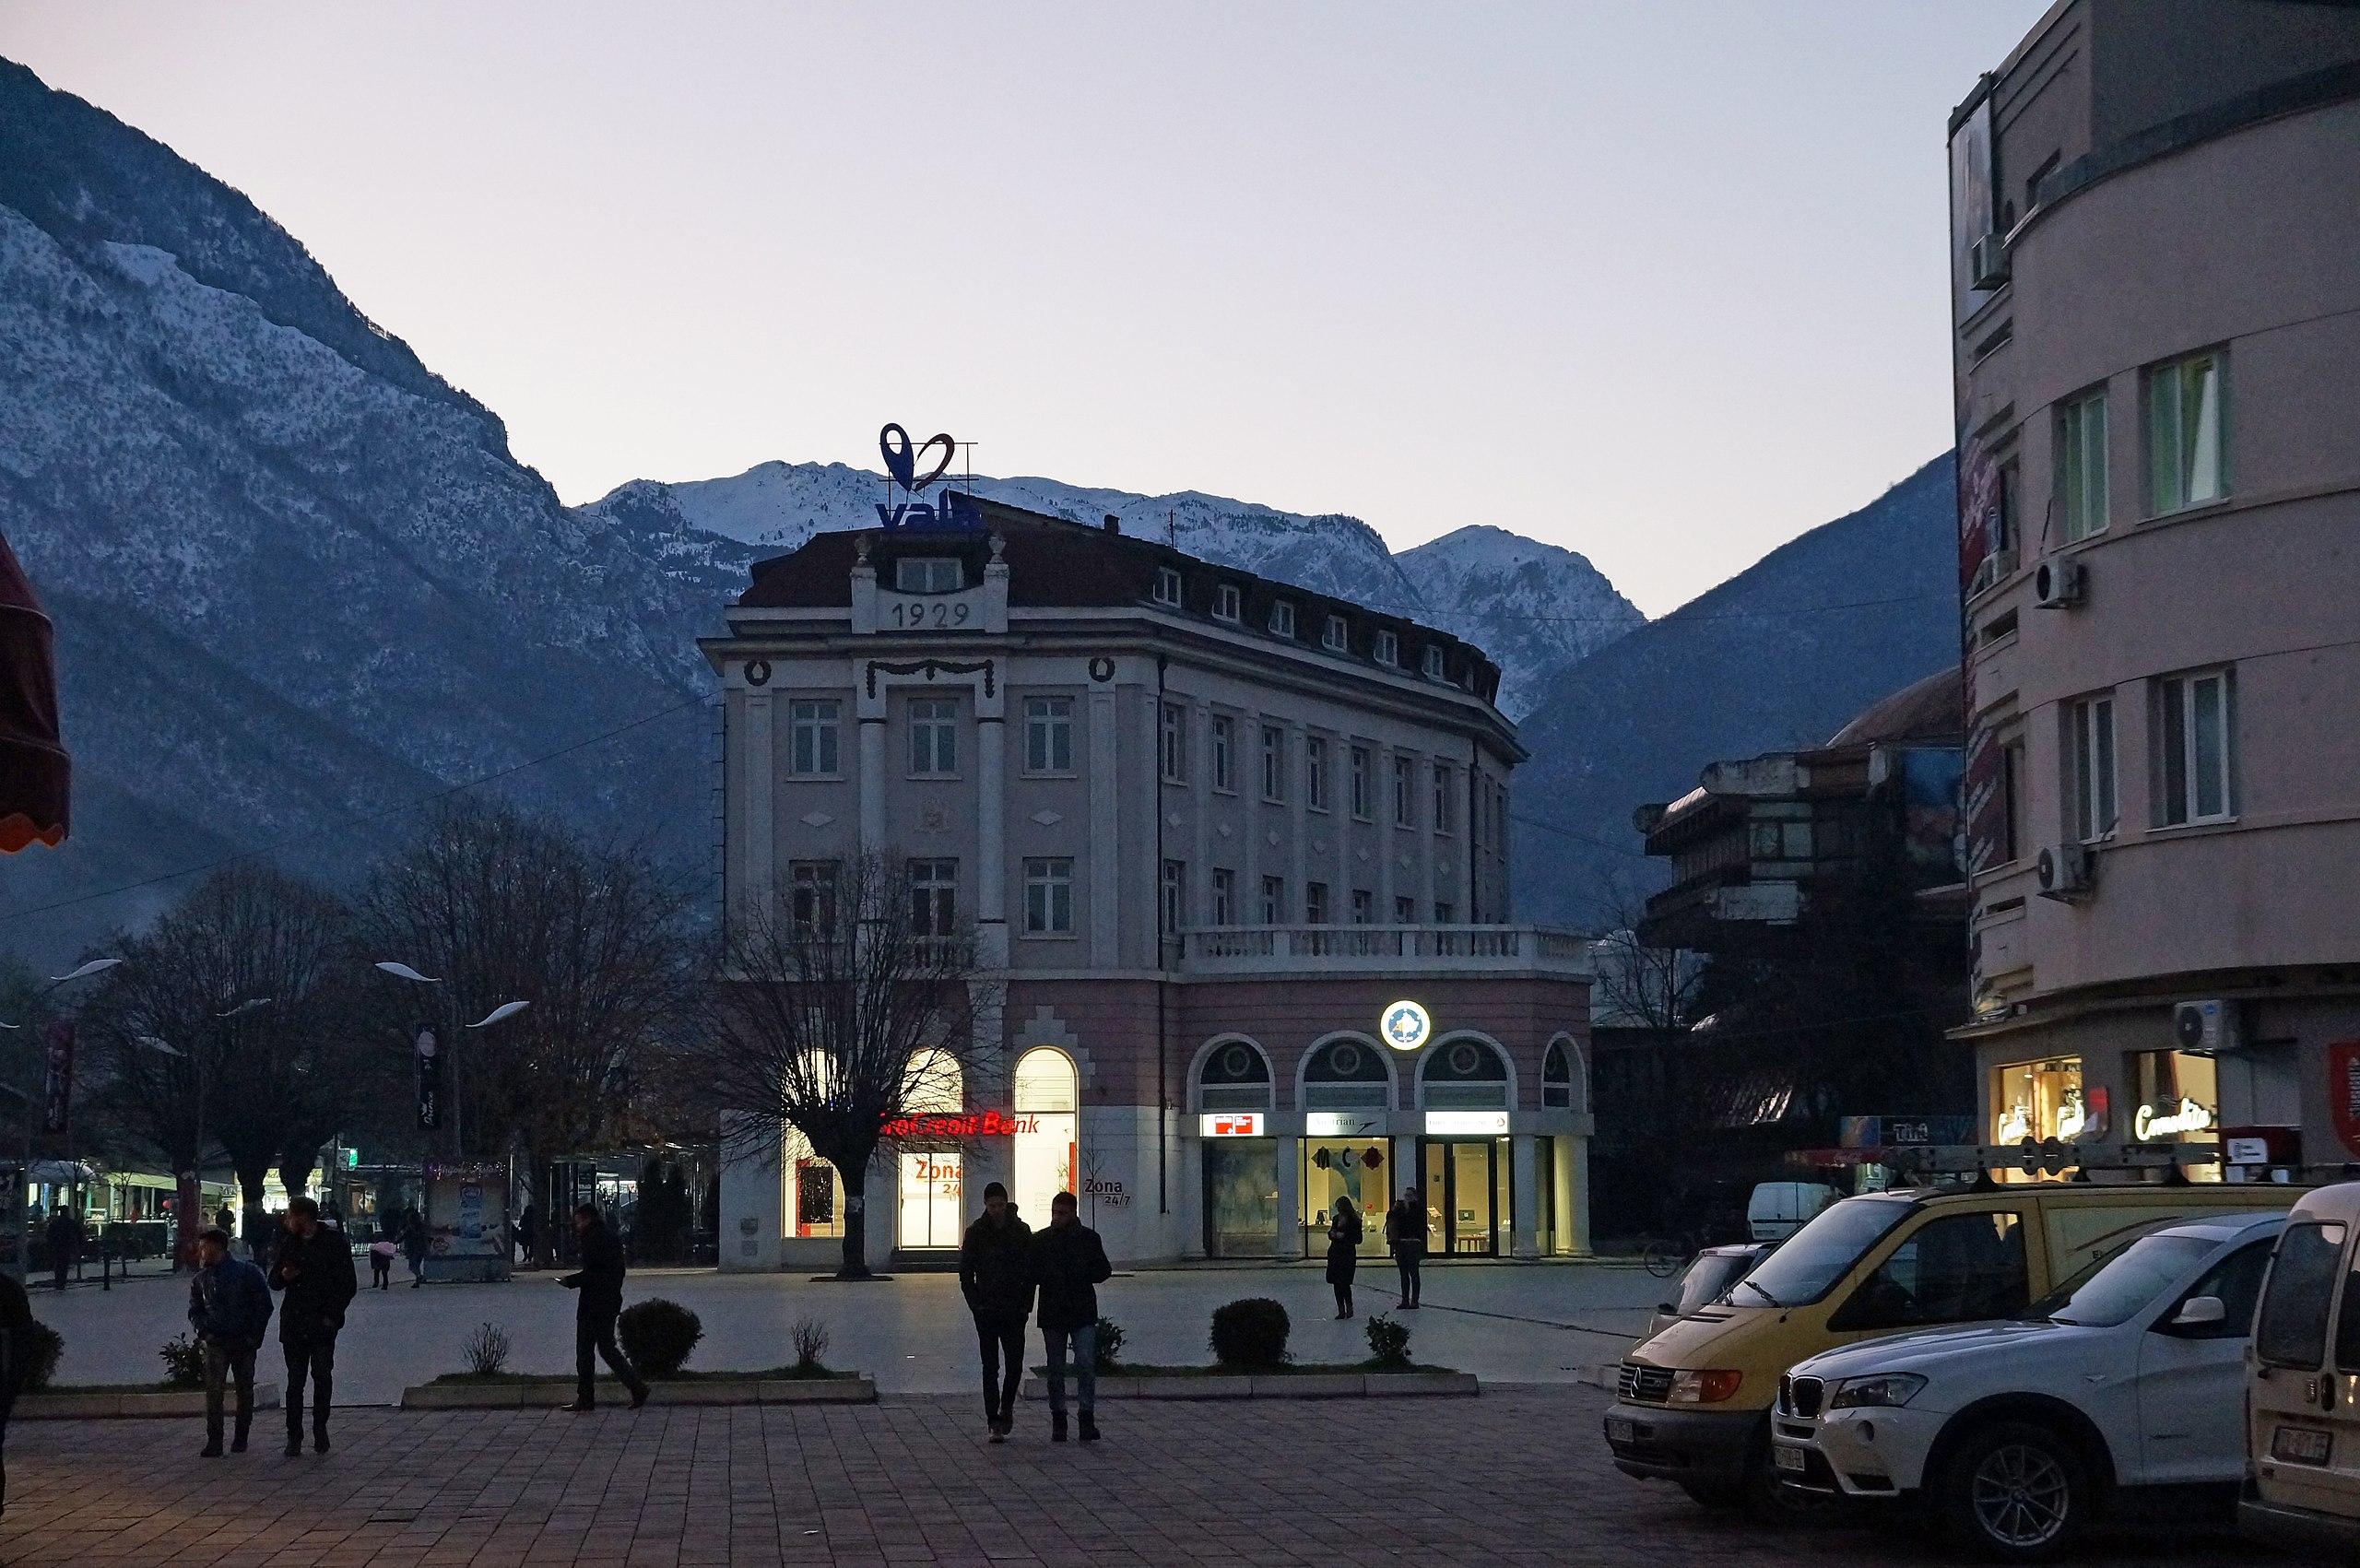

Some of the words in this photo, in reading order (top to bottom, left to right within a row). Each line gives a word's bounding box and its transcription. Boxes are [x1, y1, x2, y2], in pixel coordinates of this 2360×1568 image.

[892, 603, 970, 628] 1929
[879, 1111, 978, 1136] roCredit
[982, 1110, 1041, 1136] Bank
[1315, 1116, 1356, 1126] Austrian
[1085, 1178, 1123, 1193] Zona
[1104, 1193, 1131, 1207] 24/7
